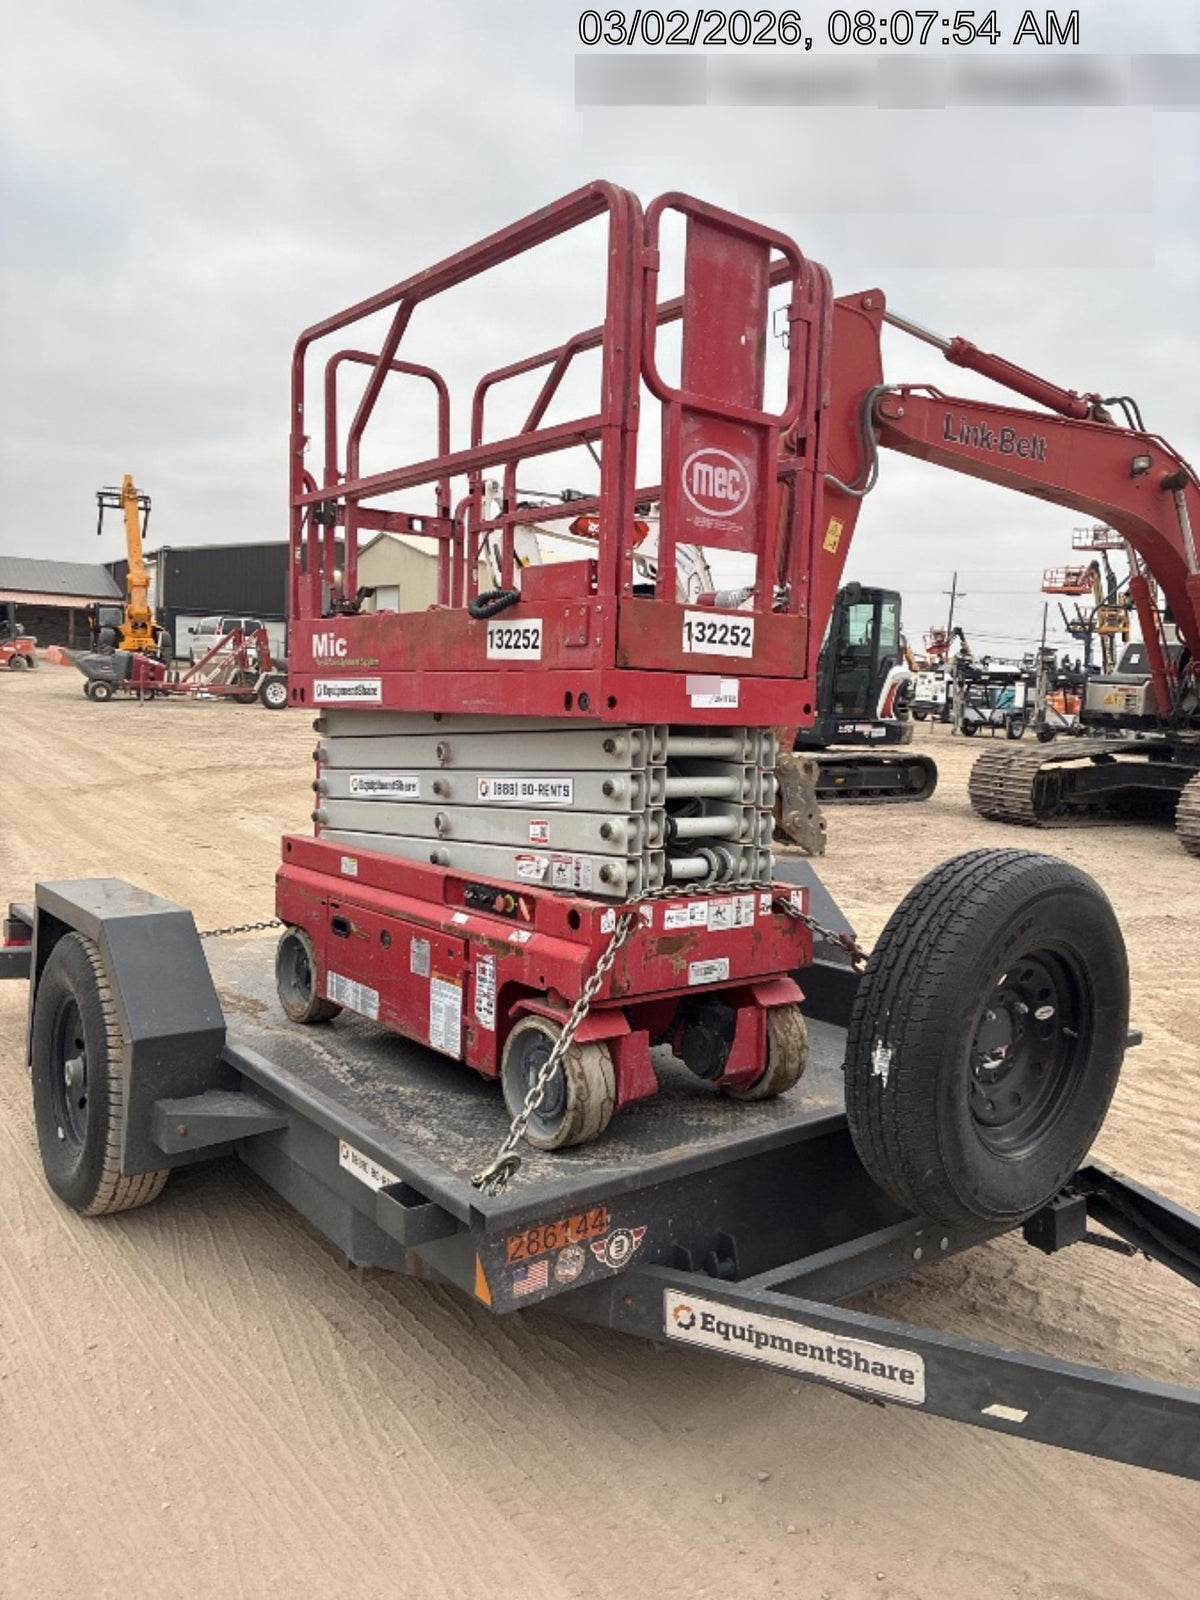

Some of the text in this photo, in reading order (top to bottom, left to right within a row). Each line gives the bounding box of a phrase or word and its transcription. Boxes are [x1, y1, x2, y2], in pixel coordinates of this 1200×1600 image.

[488, 628, 540, 650] 132252
[684, 621, 751, 648] 132252
[700, 1312, 915, 1387] EquipmentShare
